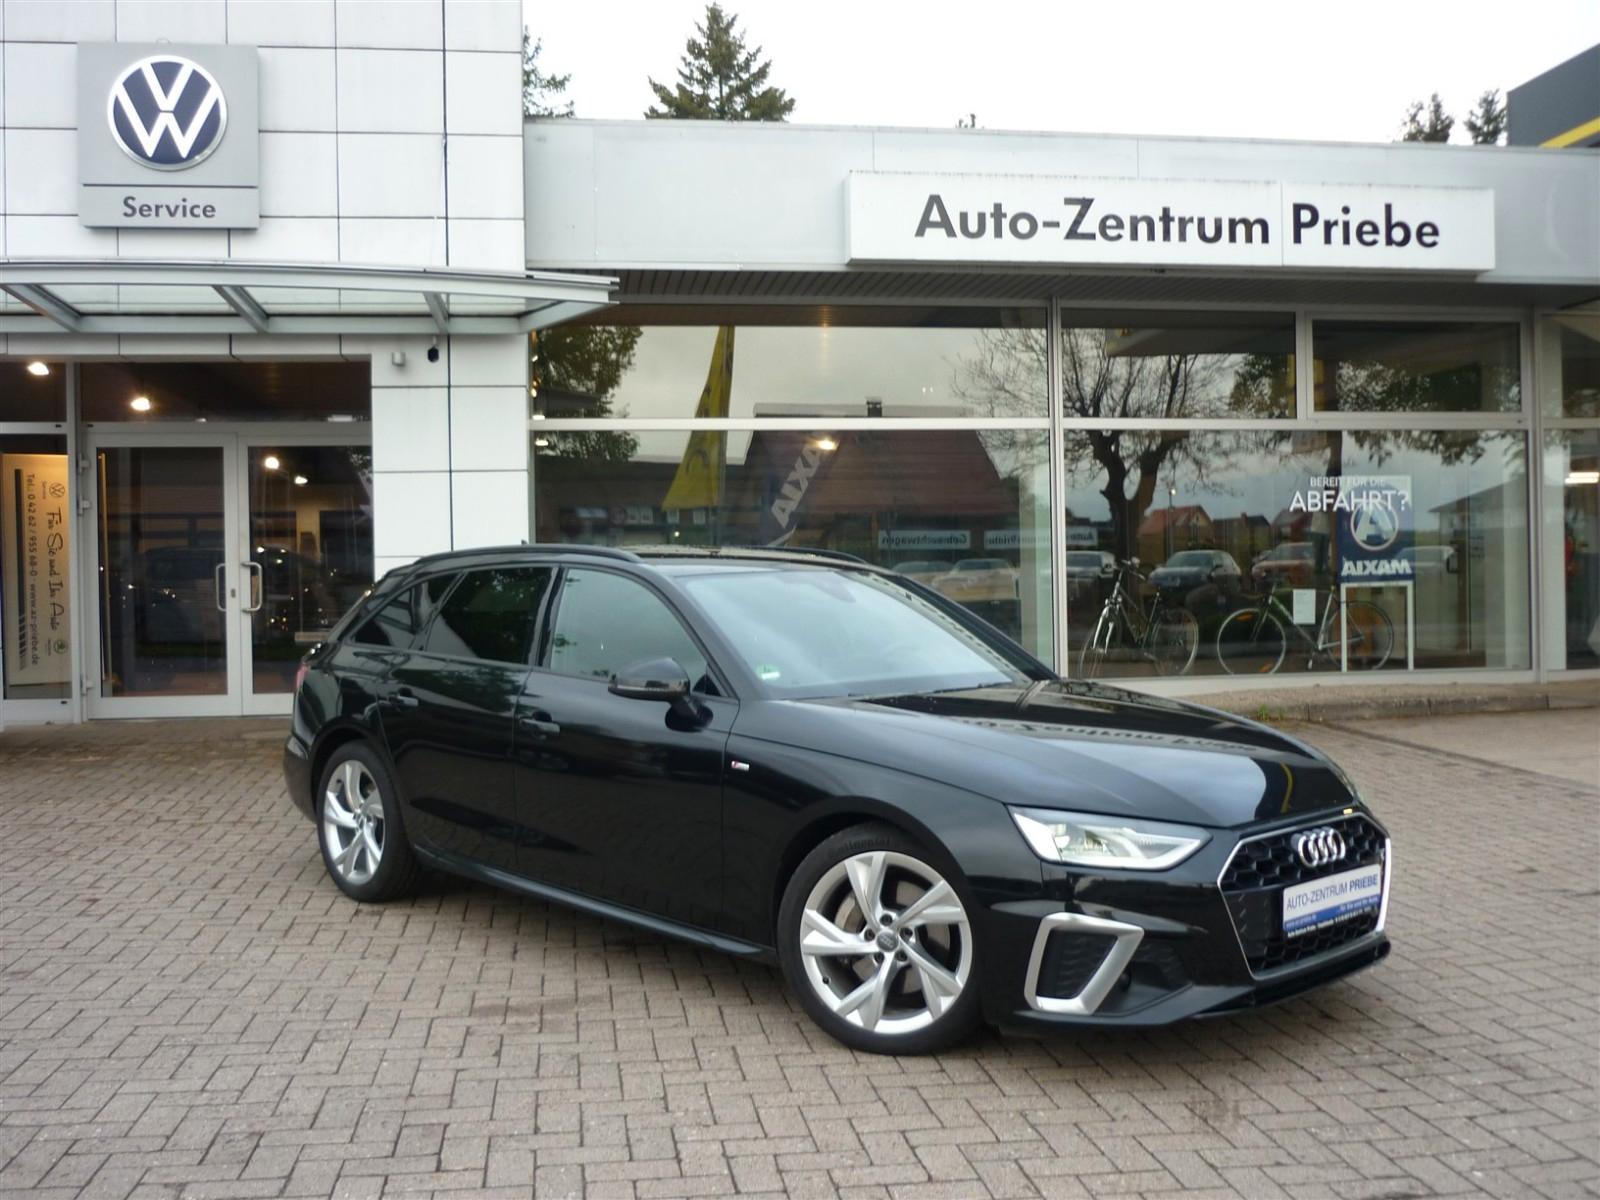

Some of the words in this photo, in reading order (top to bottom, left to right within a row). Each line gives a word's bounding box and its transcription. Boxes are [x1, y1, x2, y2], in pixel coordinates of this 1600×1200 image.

[110, 57, 225, 165] VW
[122, 196, 217, 218] Service
[914, 194, 1270, 245] Auto-Zentrum
[1292, 203, 1440, 247] Priebe
[770, 438, 830, 529] AIXA
[1289, 490, 1410, 512] ABFAHRT?
[46, 505, 62, 530] Für
[46, 532, 64, 556] Sie
[48, 558, 60, 578] und
[1341, 558, 1412, 576] AIXAM
[48, 580, 65, 598] Ihr
[30, 583, 40, 665] www.az-priebe.de
[50, 602, 65, 632] Auto
[1286, 881, 1348, 911] AUTO-ZENTRUM
[1349, 873, 1378, 892] PRIEBE
